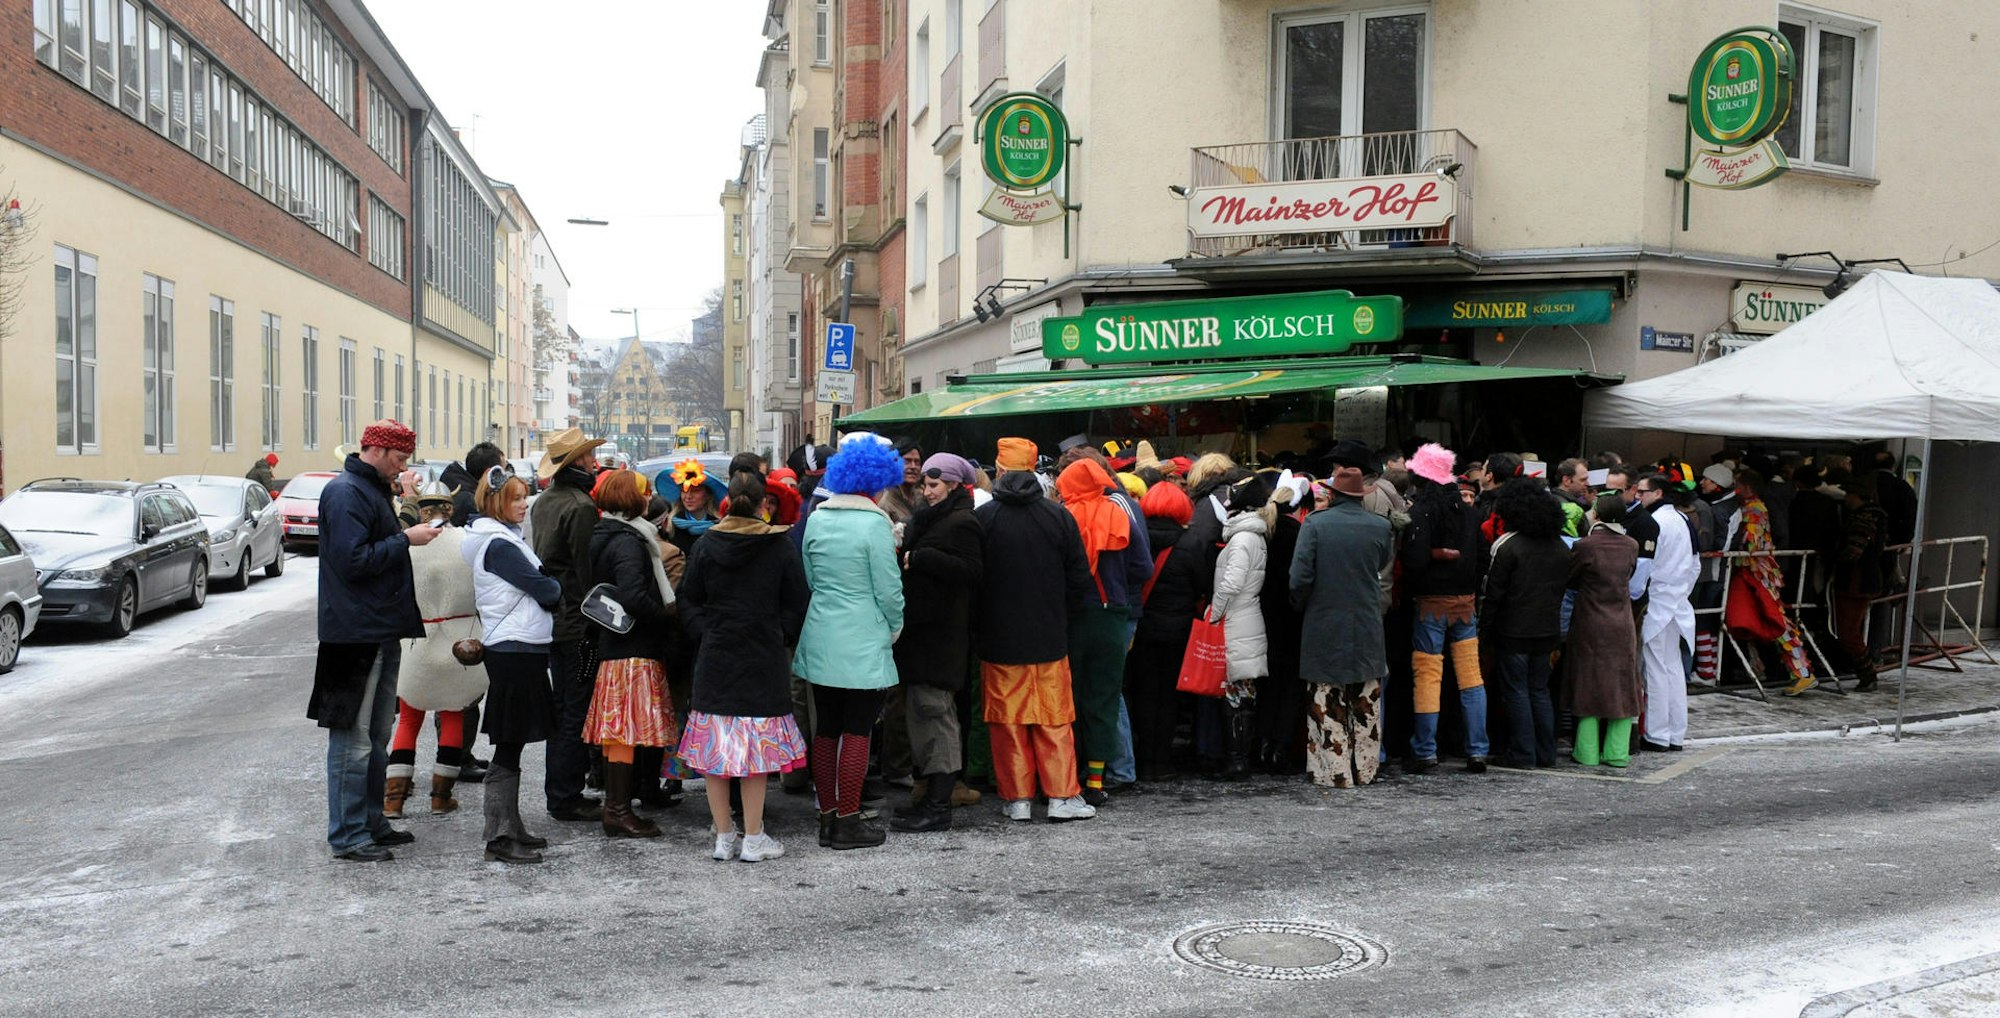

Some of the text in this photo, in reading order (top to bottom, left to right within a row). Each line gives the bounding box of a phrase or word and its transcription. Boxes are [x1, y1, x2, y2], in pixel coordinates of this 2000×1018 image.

[1702, 153, 1762, 171] Mainzer
[1717, 169, 1743, 184] Hof
[997, 195, 1051, 210] Mainzer
[1201, 182, 1439, 225] Mainzer Hof
[1011, 208, 1036, 222] Hof
[1533, 303, 1575, 314] KÖLSCH
[1744, 291, 1826, 323] SÜNNE
[831, 327, 844, 347] P
[1095, 313, 1335, 353] SÜNNER KÖLSCH
[1656, 333, 1682, 348] Mainzer
